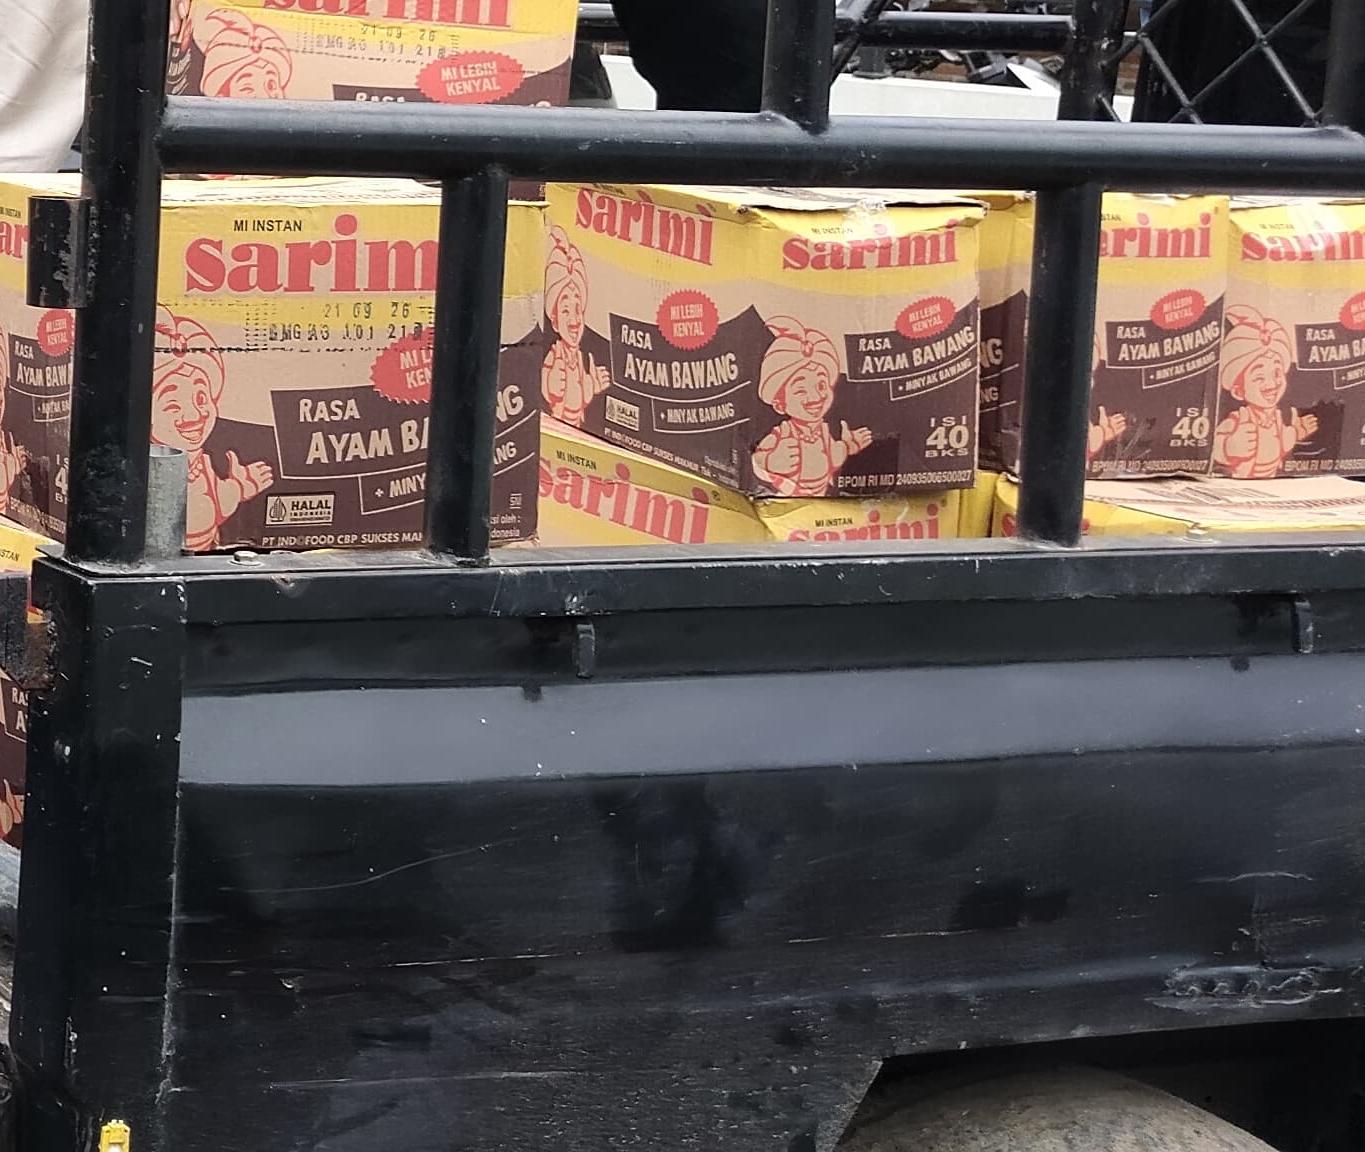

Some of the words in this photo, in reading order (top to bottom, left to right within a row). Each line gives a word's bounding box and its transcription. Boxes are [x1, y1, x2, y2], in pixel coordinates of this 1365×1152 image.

[441, 67, 458, 82] MI
[446, 77, 501, 97] KENYAL
[233, 220, 249, 232] MI
[252, 220, 302, 233] INSTAN
[575, 188, 714, 267] sarimi
[1099, 212, 1212, 258] arimi
[782, 218, 959, 271] sarimi
[1241, 219, 1365, 262] sarim
[185, 214, 439, 293] sarim
[391, 301, 411, 319] 26
[621, 324, 653, 351] RASA
[673, 321, 705, 338] KENYAL
[1116, 326, 1146, 339] RASA
[1306, 328, 1336, 341] RASA
[14, 341, 35, 360] RASA
[858, 338, 892, 352] RASA
[861, 355, 909, 375] AYAM
[912, 326, 976, 364] BAWANG
[1118, 343, 1160, 361] AYAM
[1163, 321, 1220, 356] BAWANG
[400, 349, 418, 370] MI
[1308, 344, 1350, 364] AYAM
[16, 362, 44, 387] AYAM
[405, 370, 433, 389] KEN
[624, 353, 670, 388] AYAM
[671, 352, 739, 390] BAWANG
[938, 358, 972, 381] BAWANG
[299, 398, 361, 423] RASA
[666, 407, 699, 424] MINYAK
[698, 402, 736, 422] BAWANG
[1175, 407, 1209, 417] ISI
[929, 415, 968, 428] ISI
[1171, 416, 1211, 440] 40
[305, 428, 394, 465] AYAM
[925, 425, 970, 450] 40
[1169, 439, 1209, 448] BKS
[556, 450, 566, 461] MI
[567, 452, 597, 471] INSTAN
[924, 448, 970, 459] BKS
[54, 466, 69, 496] 4
[389, 473, 427, 498] MINY
[837, 475, 868, 489] BPOM
[867, 474, 878, 487] RI
[879, 474, 895, 487] MD
[290, 501, 332, 511] HALAL
[825, 517, 854, 528] INSTAN
[262, 536, 275, 546] PT
[277, 535, 334, 547] INDOFOOD
[337, 534, 358, 545] CBP
[361, 533, 399, 544] SUKSES
[491, 528, 521, 539] donesia
[12, 687, 29, 706] RA
